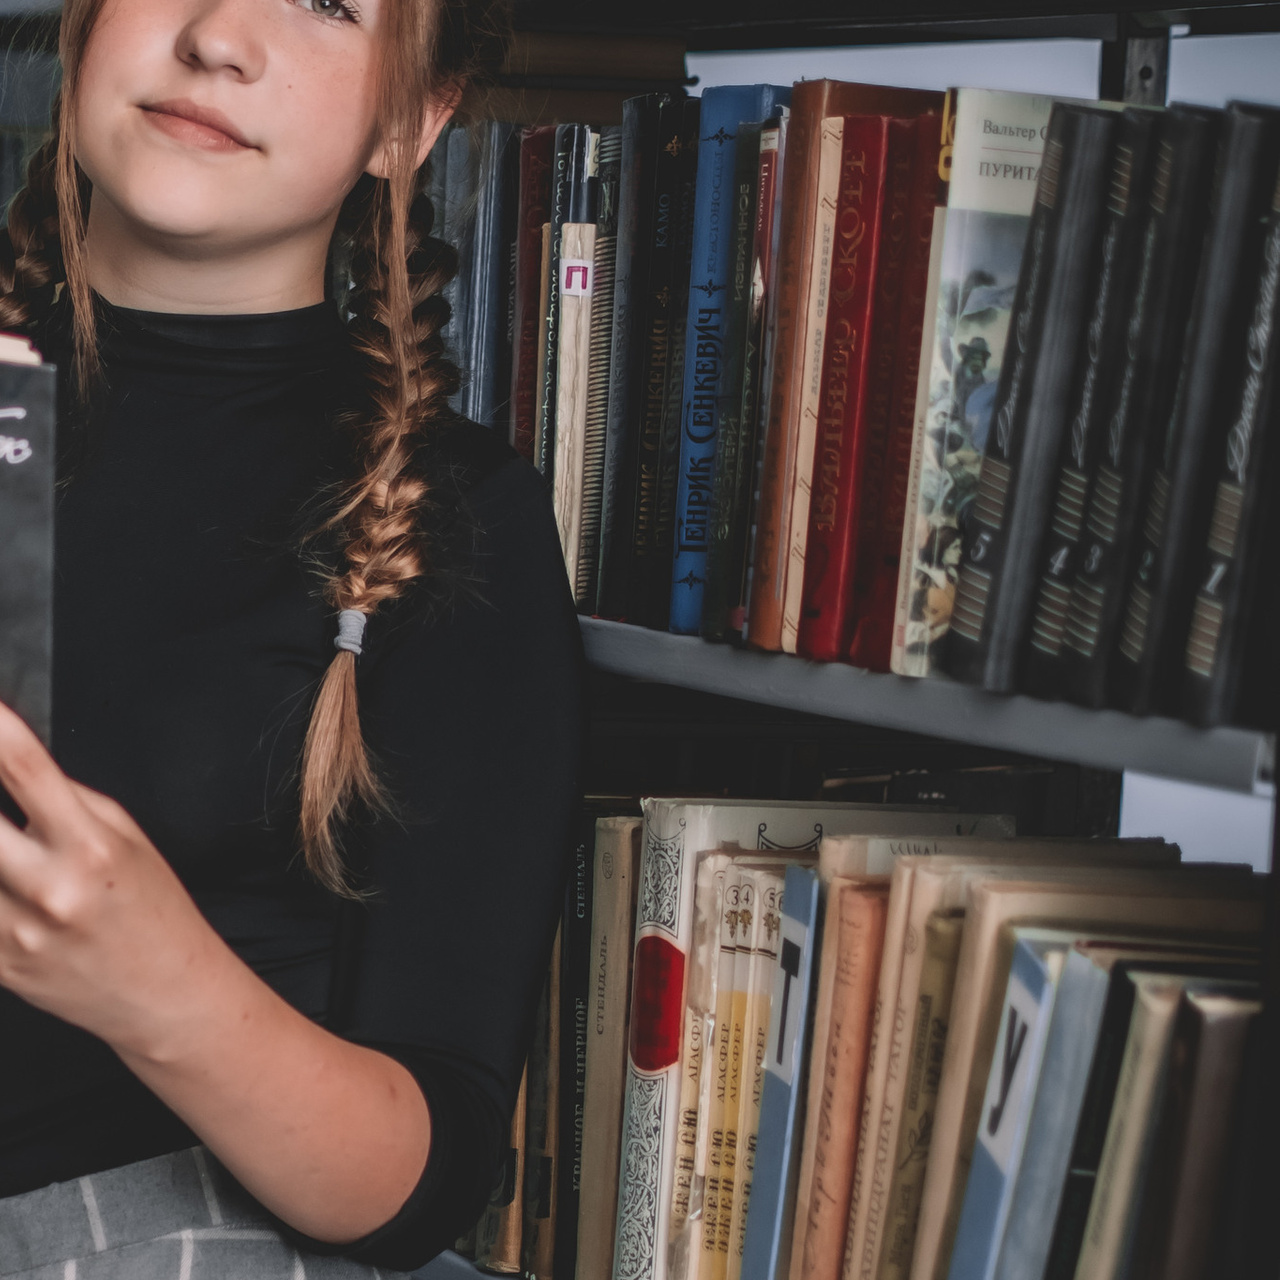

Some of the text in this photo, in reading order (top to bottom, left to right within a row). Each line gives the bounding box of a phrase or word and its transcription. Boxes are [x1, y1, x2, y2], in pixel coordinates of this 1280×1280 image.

[983, 119, 1036, 141] Вальтер
[654, 194, 670, 248] КАМО
[756, 163, 770, 232] Цитадель
[734, 183, 751, 301] ИЗБРАННОЕ
[565, 266, 588, 290] П
[815, 149, 865, 531] ВАЛЬТЕР СКОТТ
[674, 308, 724, 559] ГЕНРИК СЕНКЕВИЧ
[970, 534, 989, 561] 5
[1049, 547, 1068, 576] 4
[1086, 545, 1102, 573] 3
[1204, 563, 1227, 595] 1
[731, 889, 739, 906] 3
[743, 889, 750, 905] 4
[595, 935, 608, 1035] СТЕНДАЛЬ
[778, 937, 801, 1065] Т
[728, 1022, 742, 1104] АГАСФЕР
[750, 1026, 766, 1107] АГАСФЕР
[885, 997, 907, 1086] ТАГОР
[987, 1007, 1028, 1136] У
[676, 1107, 697, 1147] СЮ
[701, 1022, 731, 1253] ЭЖЕН СЮ АГАСФЕР
[721, 1130, 738, 1169] СЮ
